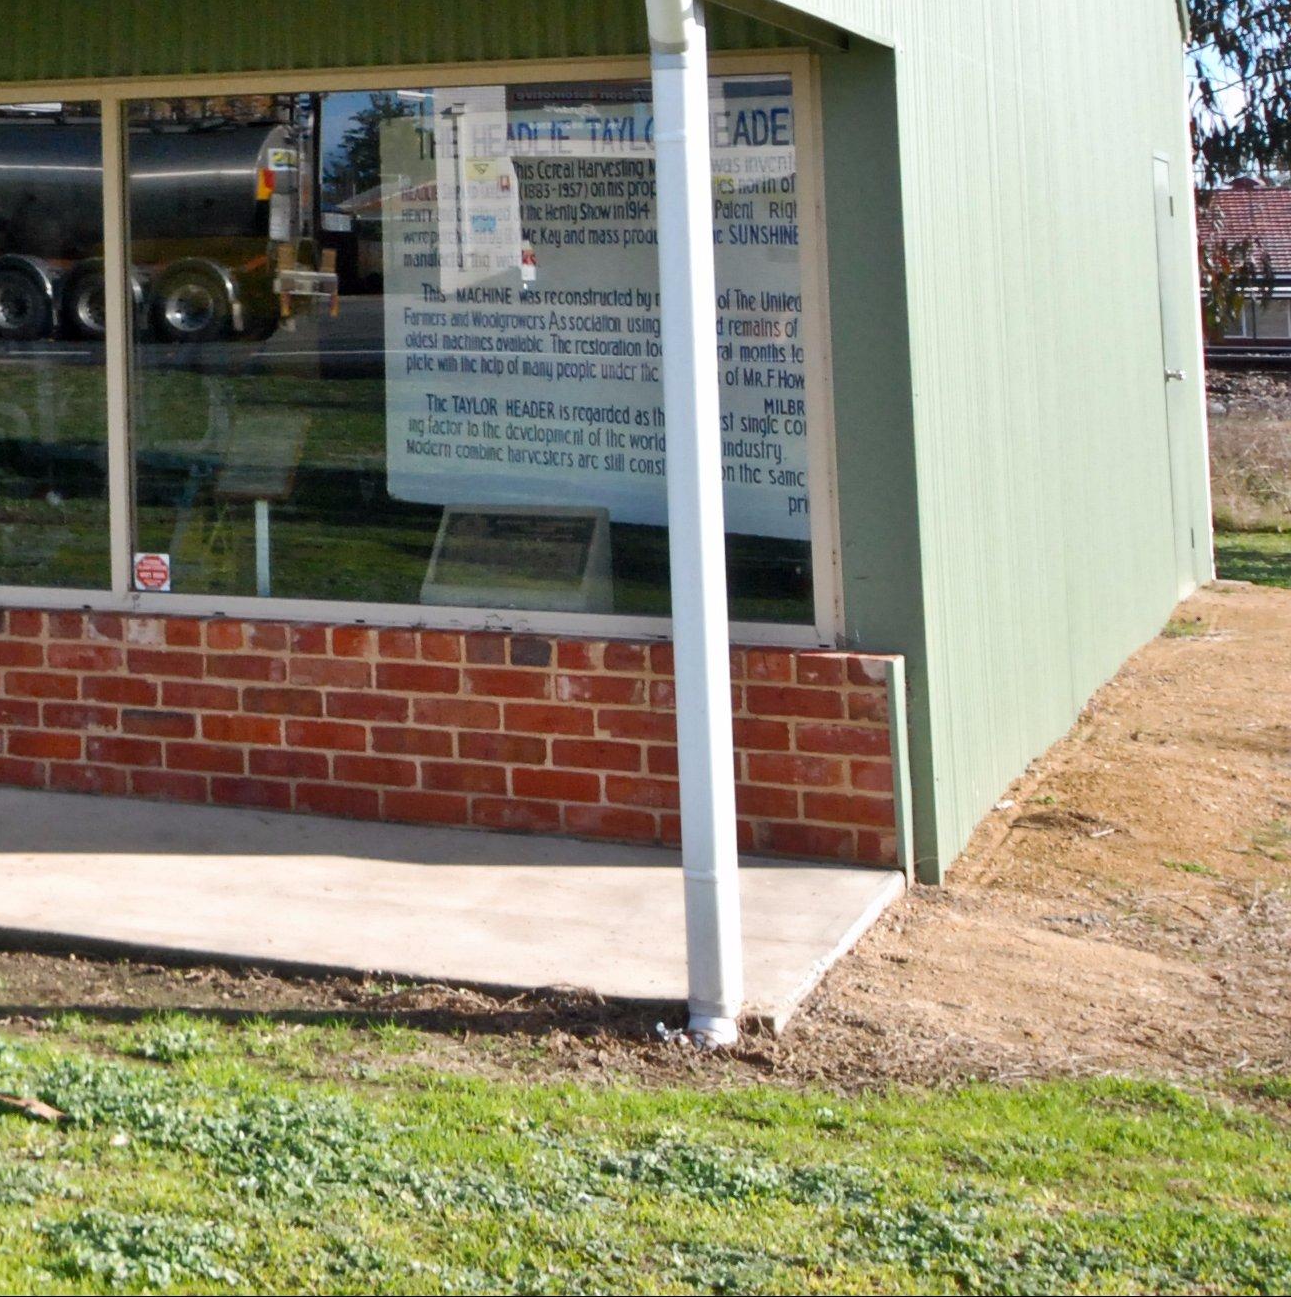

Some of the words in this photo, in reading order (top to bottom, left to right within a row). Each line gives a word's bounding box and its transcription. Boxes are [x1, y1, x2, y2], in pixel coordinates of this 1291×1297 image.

[710, 108, 795, 147] EADE
[537, 160, 574, 179] Cereal
[578, 159, 644, 179] Harvesting
[580, 201, 612, 220] Show
[563, 227, 585, 244] and
[588, 229, 619, 245] mass
[728, 224, 799, 245] SUNSHINE
[422, 282, 446, 303] This
[456, 286, 512, 304] MACHINE
[519, 289, 541, 305] was
[544, 287, 633, 307] reconstructed
[636, 288, 652, 311] by
[717, 288, 731, 310] of
[734, 289, 757, 311] The
[404, 307, 447, 326] Farmers
[471, 311, 546, 332] Woolgrowers
[627, 315, 661, 338] using
[729, 319, 781, 337] remains
[784, 318, 798, 338] of
[442, 334, 494, 351] machines
[550, 334, 571, 353] The
[574, 337, 642, 357] restoration
[740, 344, 786, 362] months
[481, 356, 504, 378] help
[507, 356, 520, 374] of
[523, 360, 553, 382] many
[557, 360, 597, 382] people
[601, 363, 638, 381] under
[725, 367, 739, 386] of
[426, 393, 447, 413] The
[452, 395, 498, 416] TAYLOR
[506, 399, 555, 420] HEADER
[559, 404, 570, 421] is
[573, 405, 630, 427] regarded
[634, 408, 650, 427] as
[428, 414, 463, 436] factor
[483, 421, 502, 439] the
[506, 422, 584, 446] development
[588, 428, 601, 447] of
[606, 429, 626, 449] the
[741, 416, 779, 438] single
[406, 438, 452, 458] Modern
[455, 443, 504, 462] combine
[507, 445, 575, 468] harvesters
[577, 452, 599, 470] are
[739, 463, 762, 484] the
[768, 469, 806, 488] same
